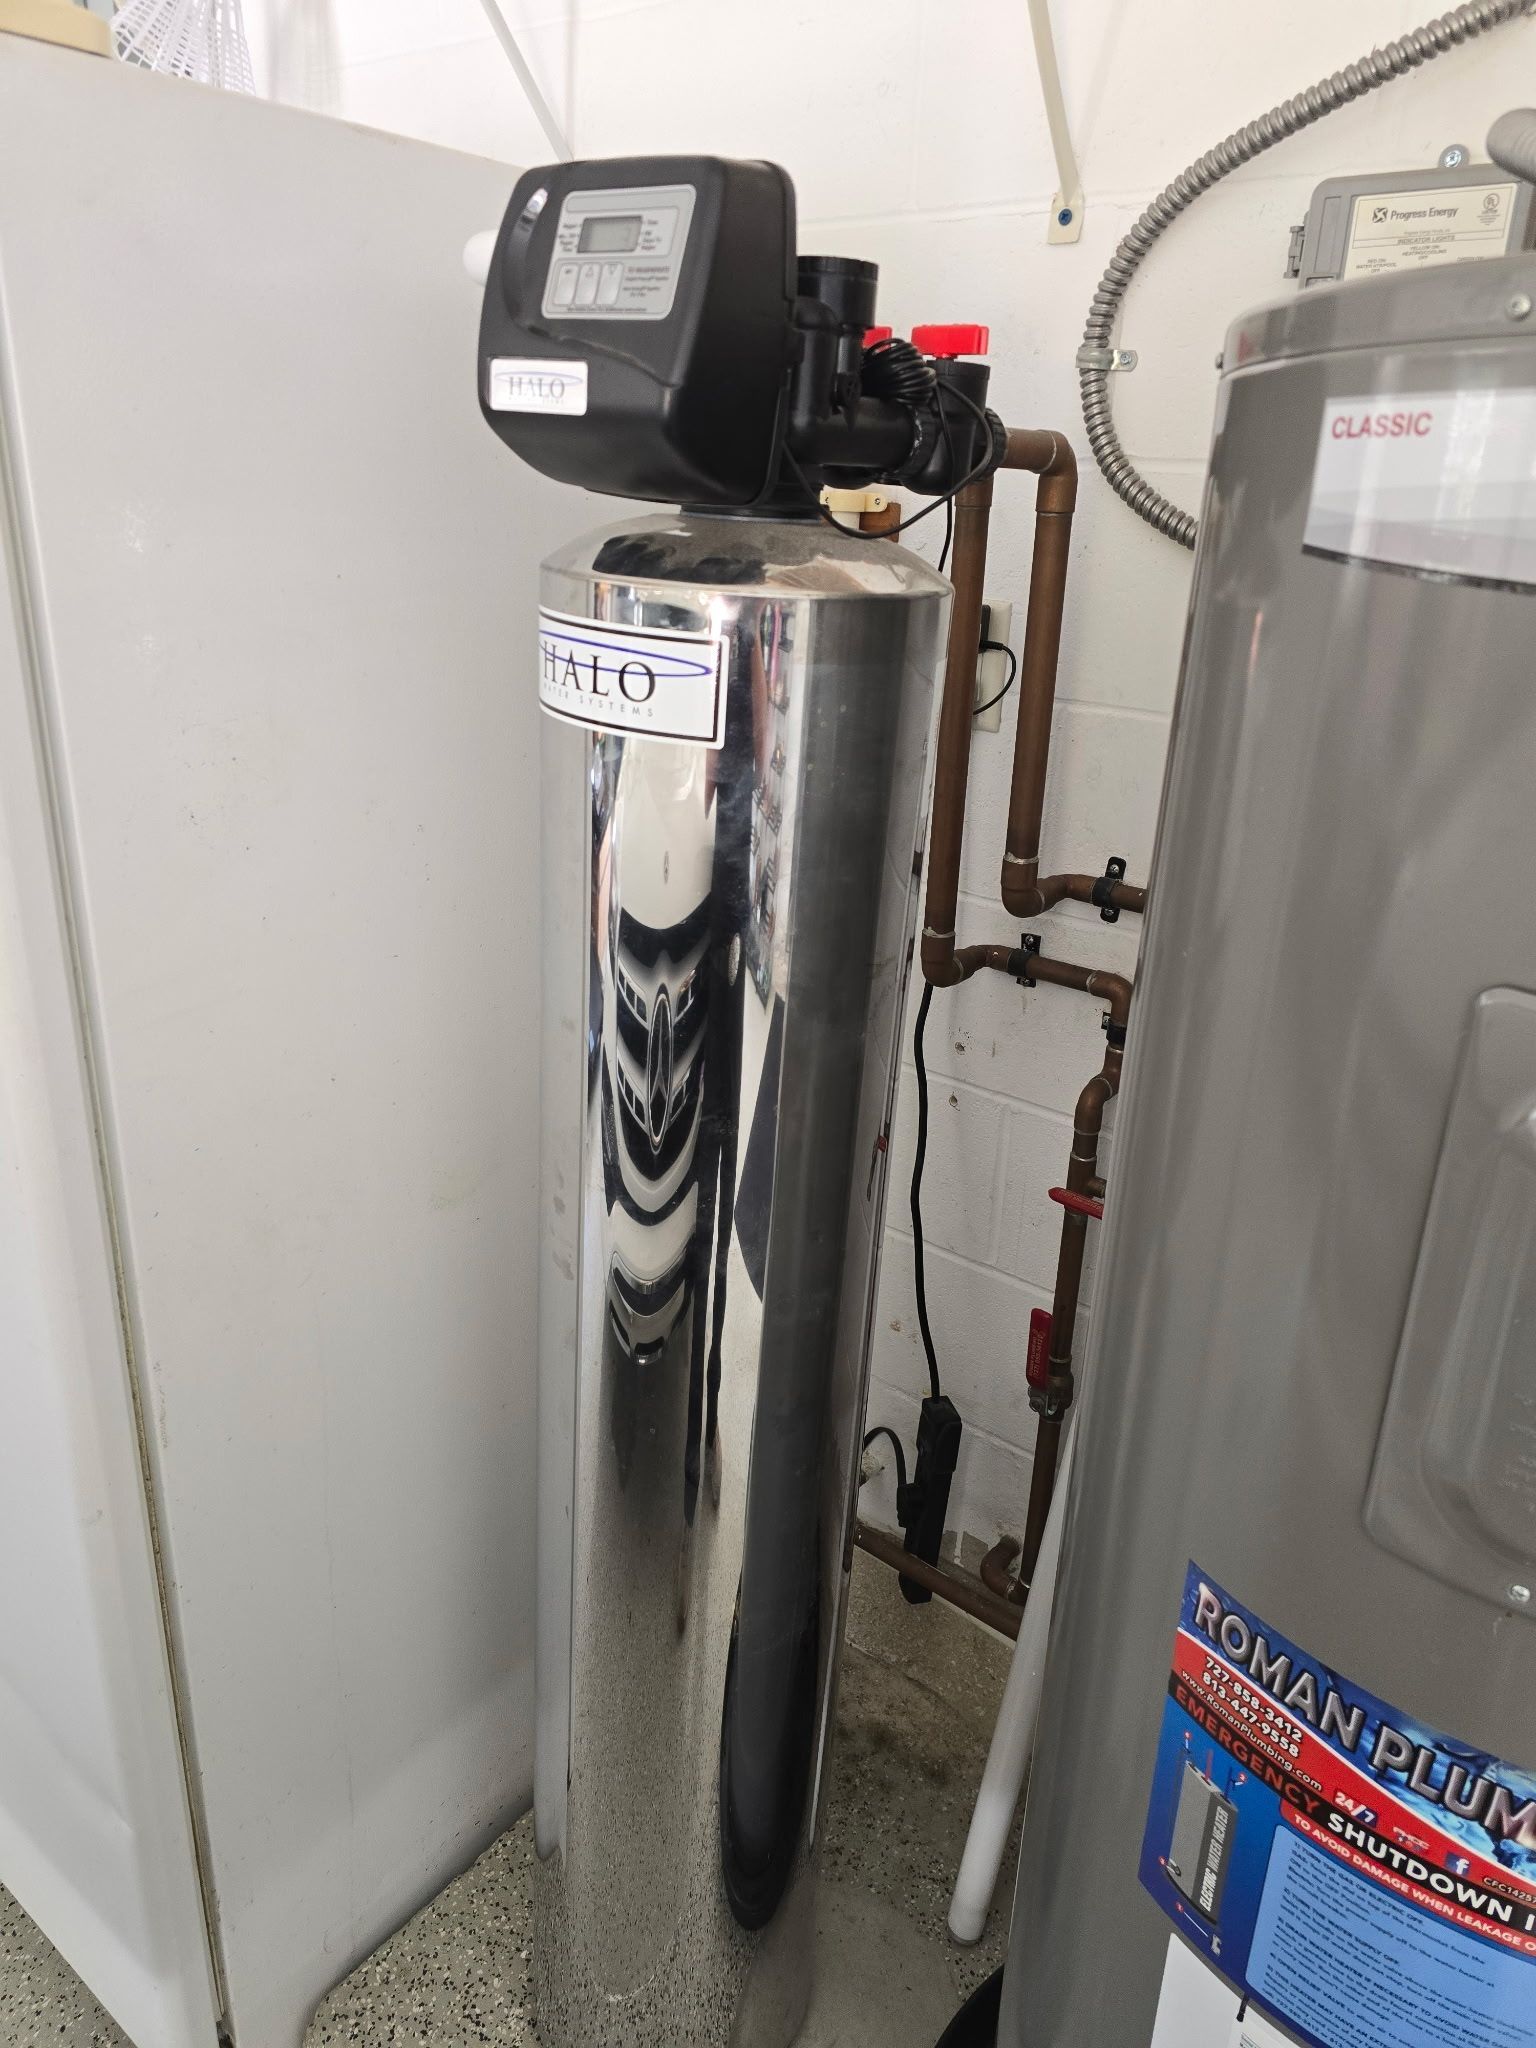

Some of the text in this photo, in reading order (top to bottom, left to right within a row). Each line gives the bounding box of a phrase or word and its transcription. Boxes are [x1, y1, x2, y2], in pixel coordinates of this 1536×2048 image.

[1390, 206, 1459, 222] Progress Energy
[1397, 237, 1431, 245] INDICATOR
[508, 376, 565, 399] HALO
[1331, 411, 1433, 439] CLASSIC
[543, 640, 656, 703] HALO
[578, 695, 655, 718] SYSTEMS
[1181, 1669, 1322, 1792] www.RomanPlumbing.com
[1194, 1581, 1536, 1848] ROMAN PLUM
[1202, 1671, 1299, 1758] 813-447-9558
[1205, 1656, 1303, 1743] 727-858-3412
[1175, 1683, 1321, 1814] EMERGENCY
[1327, 1812, 1513, 1922] SHUTDOWN
[1335, 1791, 1375, 1824] 24/7
[1200, 1805, 1229, 1912] ELECTRIC WATER HEATER
[1294, 1814, 1311, 1830] TO
[1312, 1829, 1351, 1858] AVOID
[1352, 1854, 1410, 1894] DAMAGE
[1412, 1888, 1455, 1917] WHEN
[1457, 1911, 1522, 1946] LEAKAGE
